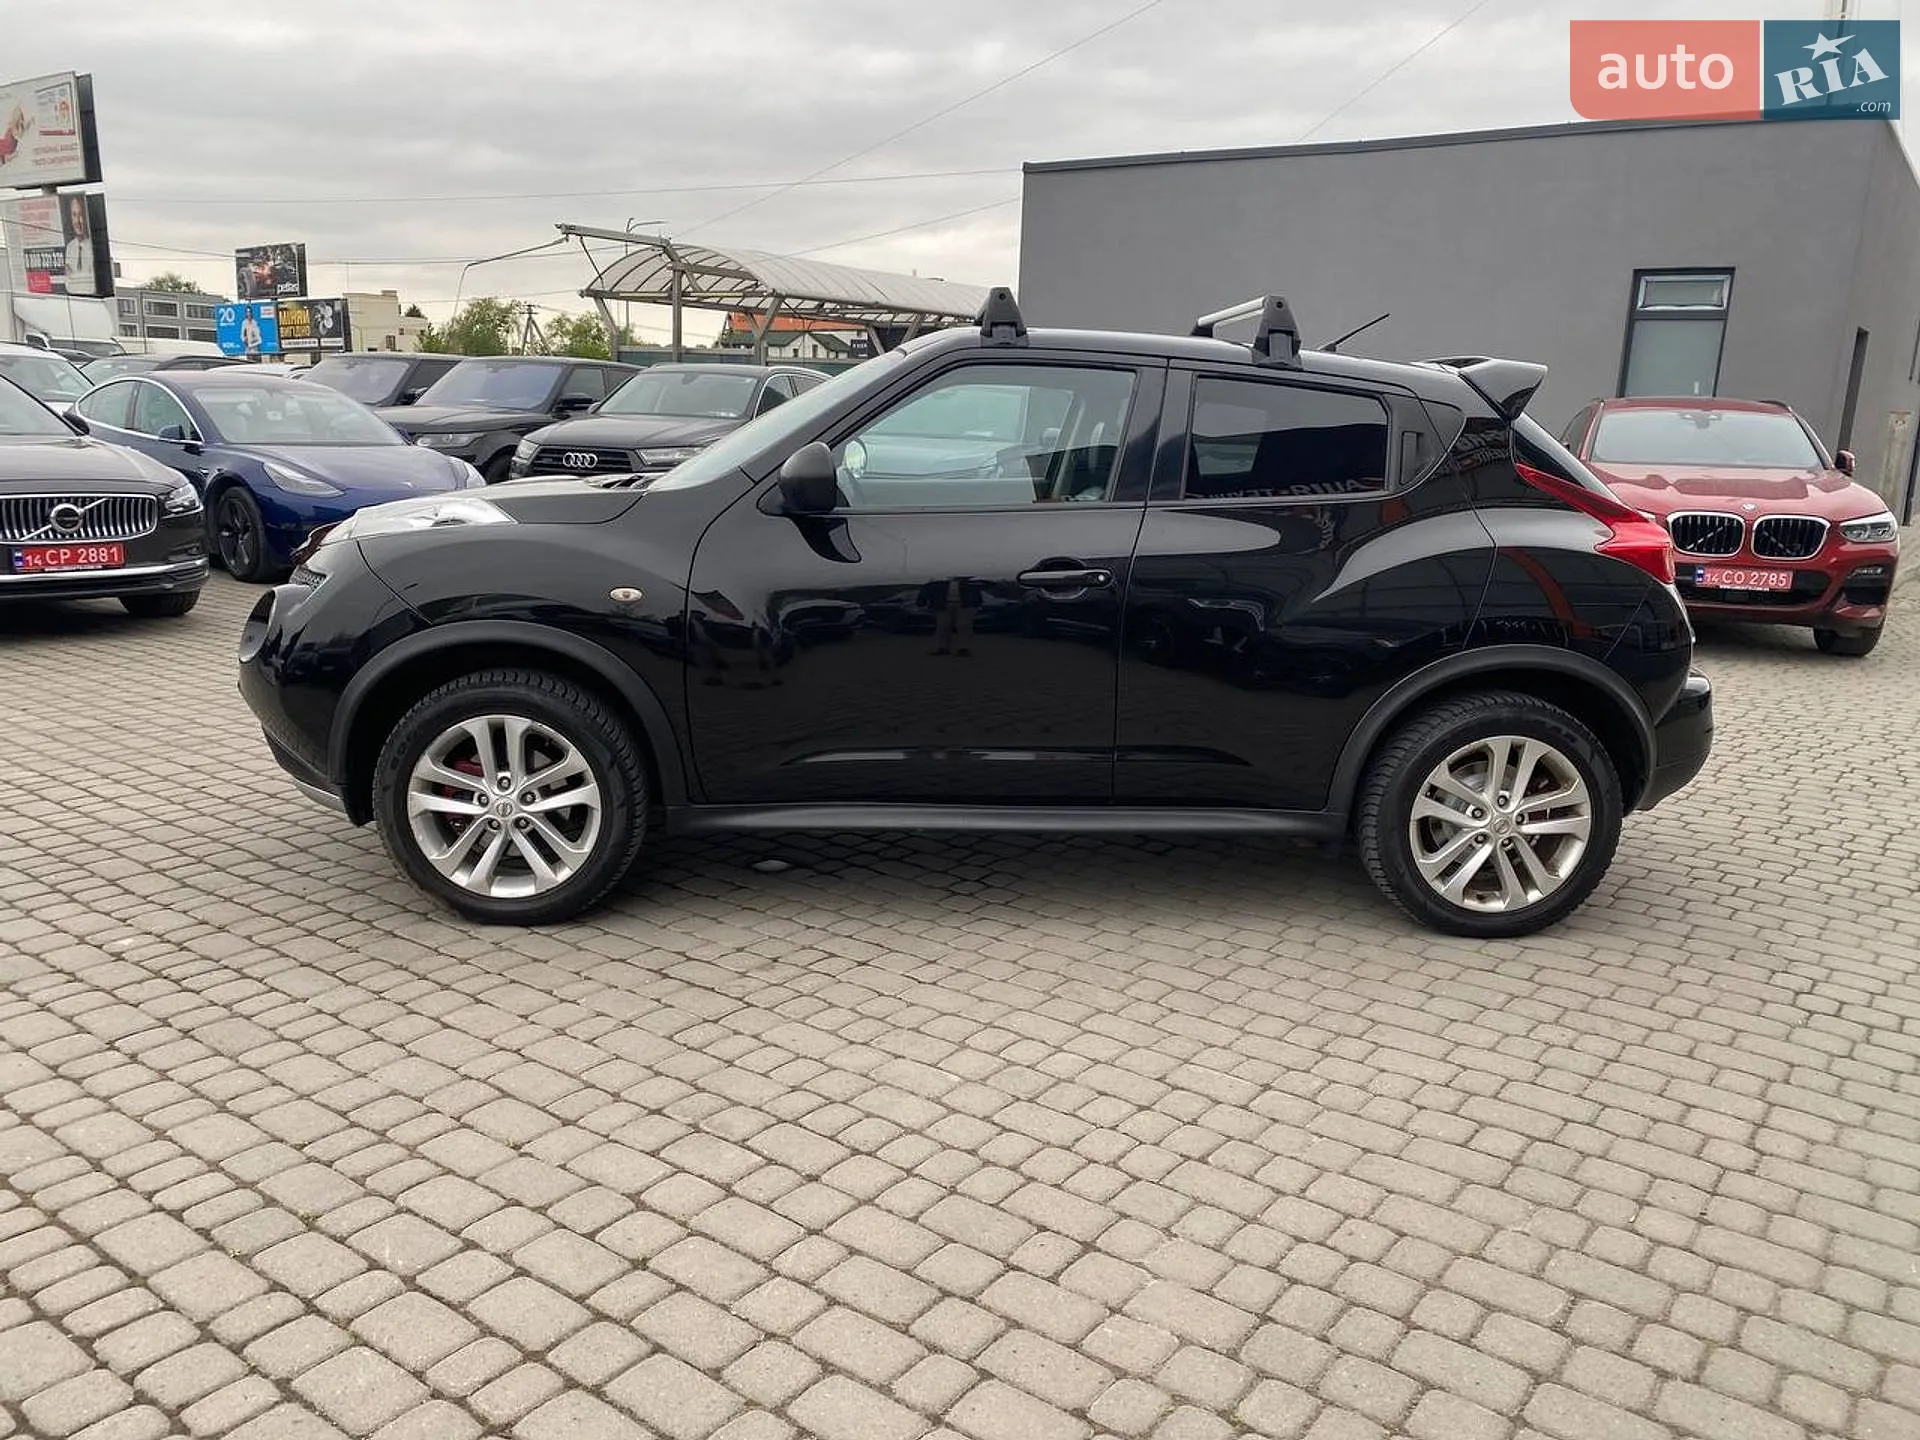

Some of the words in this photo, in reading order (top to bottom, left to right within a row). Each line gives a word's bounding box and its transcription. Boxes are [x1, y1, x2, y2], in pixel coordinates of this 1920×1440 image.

[218, 307, 236, 323] 20
[25, 554, 42, 567] 14
[46, 549, 71, 565] CP
[77, 547, 119, 564] 2881
[1722, 570, 1745, 585] CO
[1749, 572, 1788, 587] 2785
